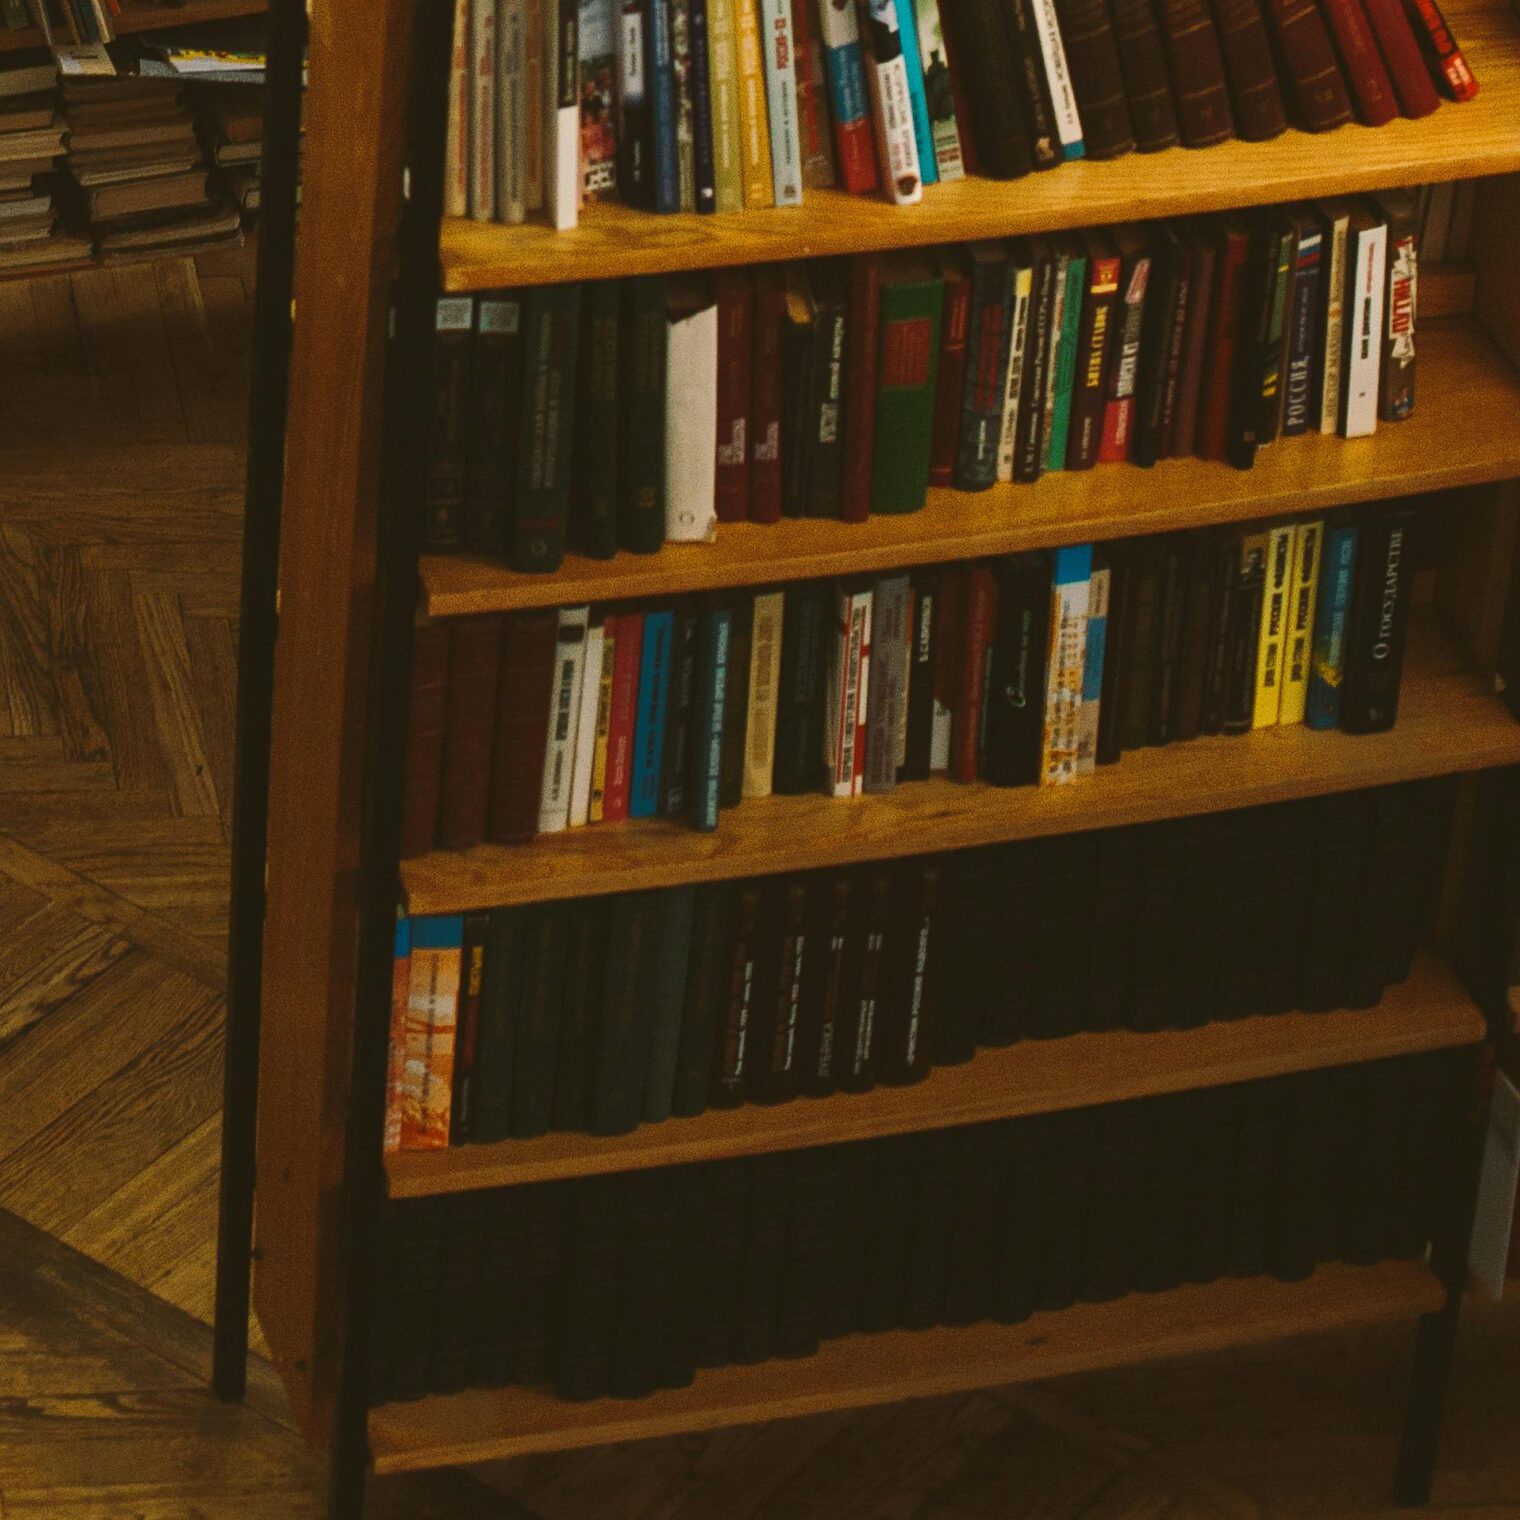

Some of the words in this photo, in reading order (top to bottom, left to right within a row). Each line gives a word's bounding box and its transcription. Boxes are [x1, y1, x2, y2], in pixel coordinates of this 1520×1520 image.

[1392, 279, 1411, 334] ПУТИН
[1378, 527, 1403, 638] ГОСУДАРСТВЕ
[1371, 641, 1391, 659] О
